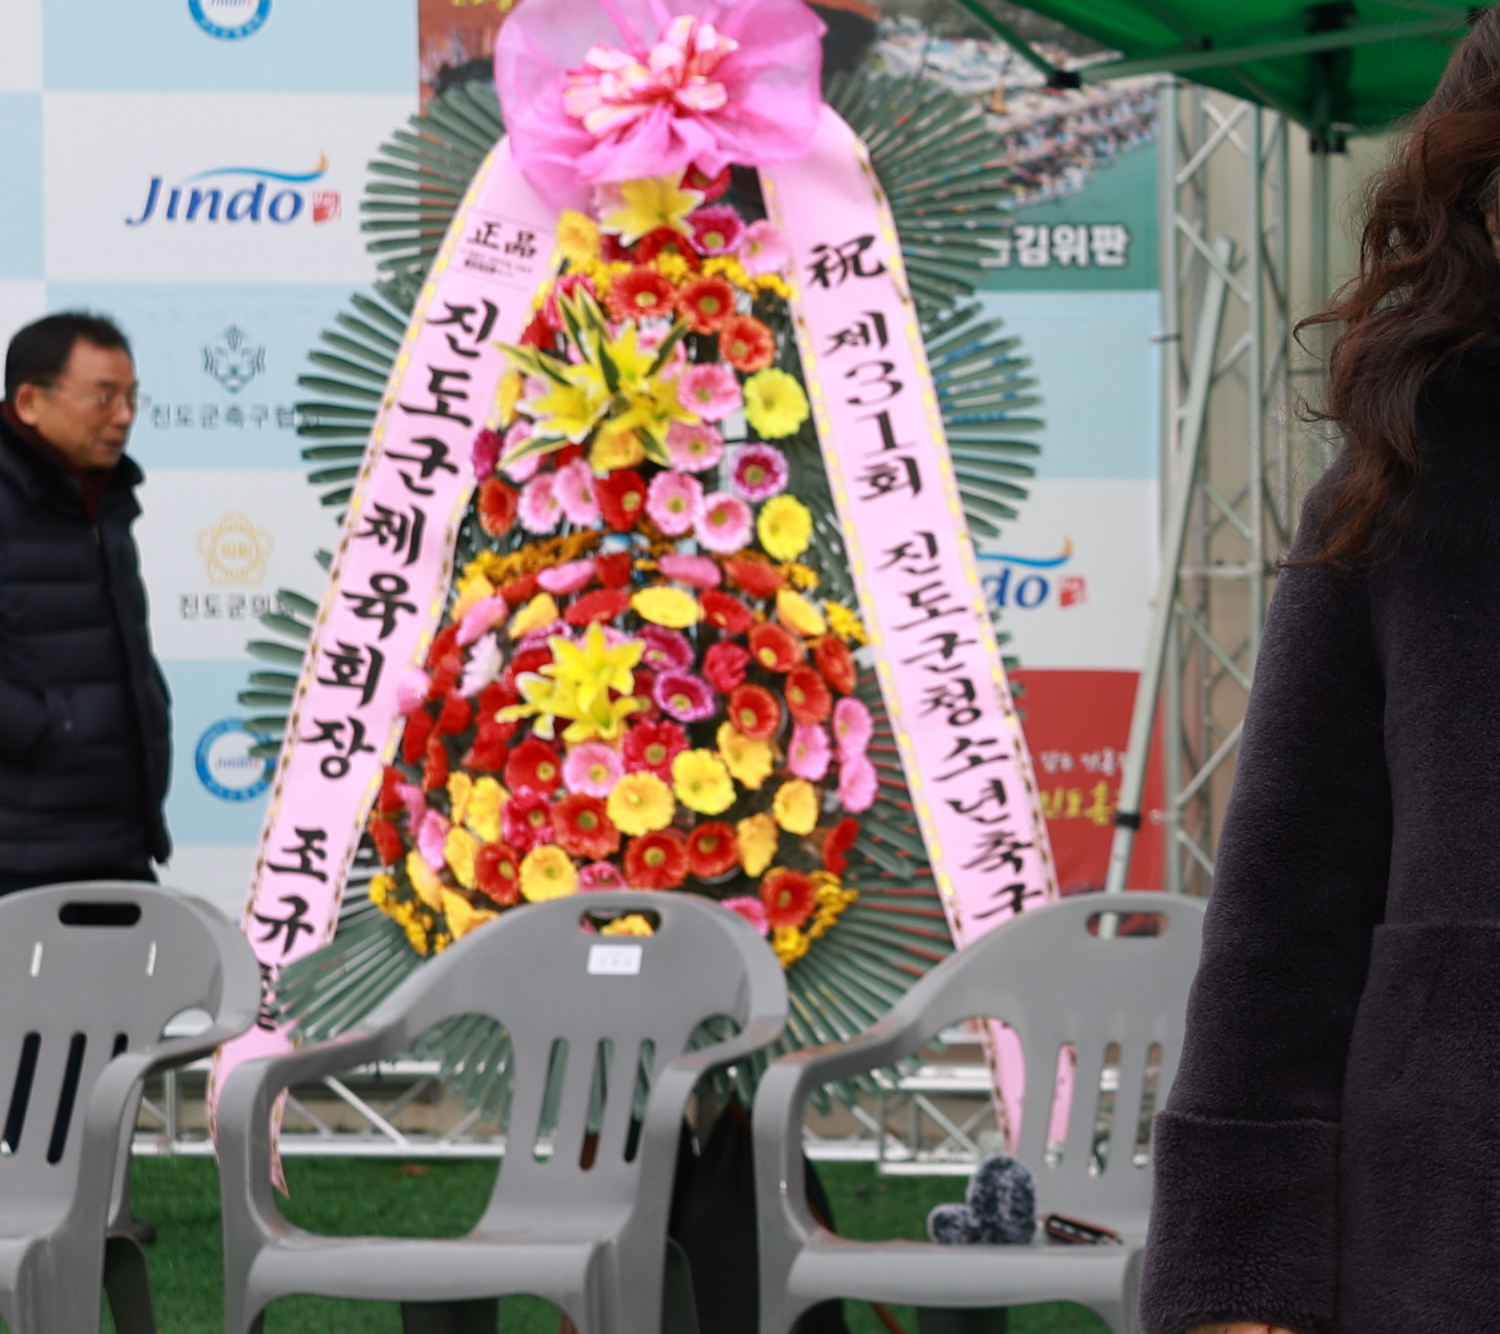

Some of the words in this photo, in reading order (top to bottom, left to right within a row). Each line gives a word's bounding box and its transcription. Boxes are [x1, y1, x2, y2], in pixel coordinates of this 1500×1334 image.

[125, 175, 306, 228] Jindo
[806, 234, 886, 289] 祝
[820, 310, 923, 502] 제31회
[301, 297, 500, 780] 진도군체육회장
